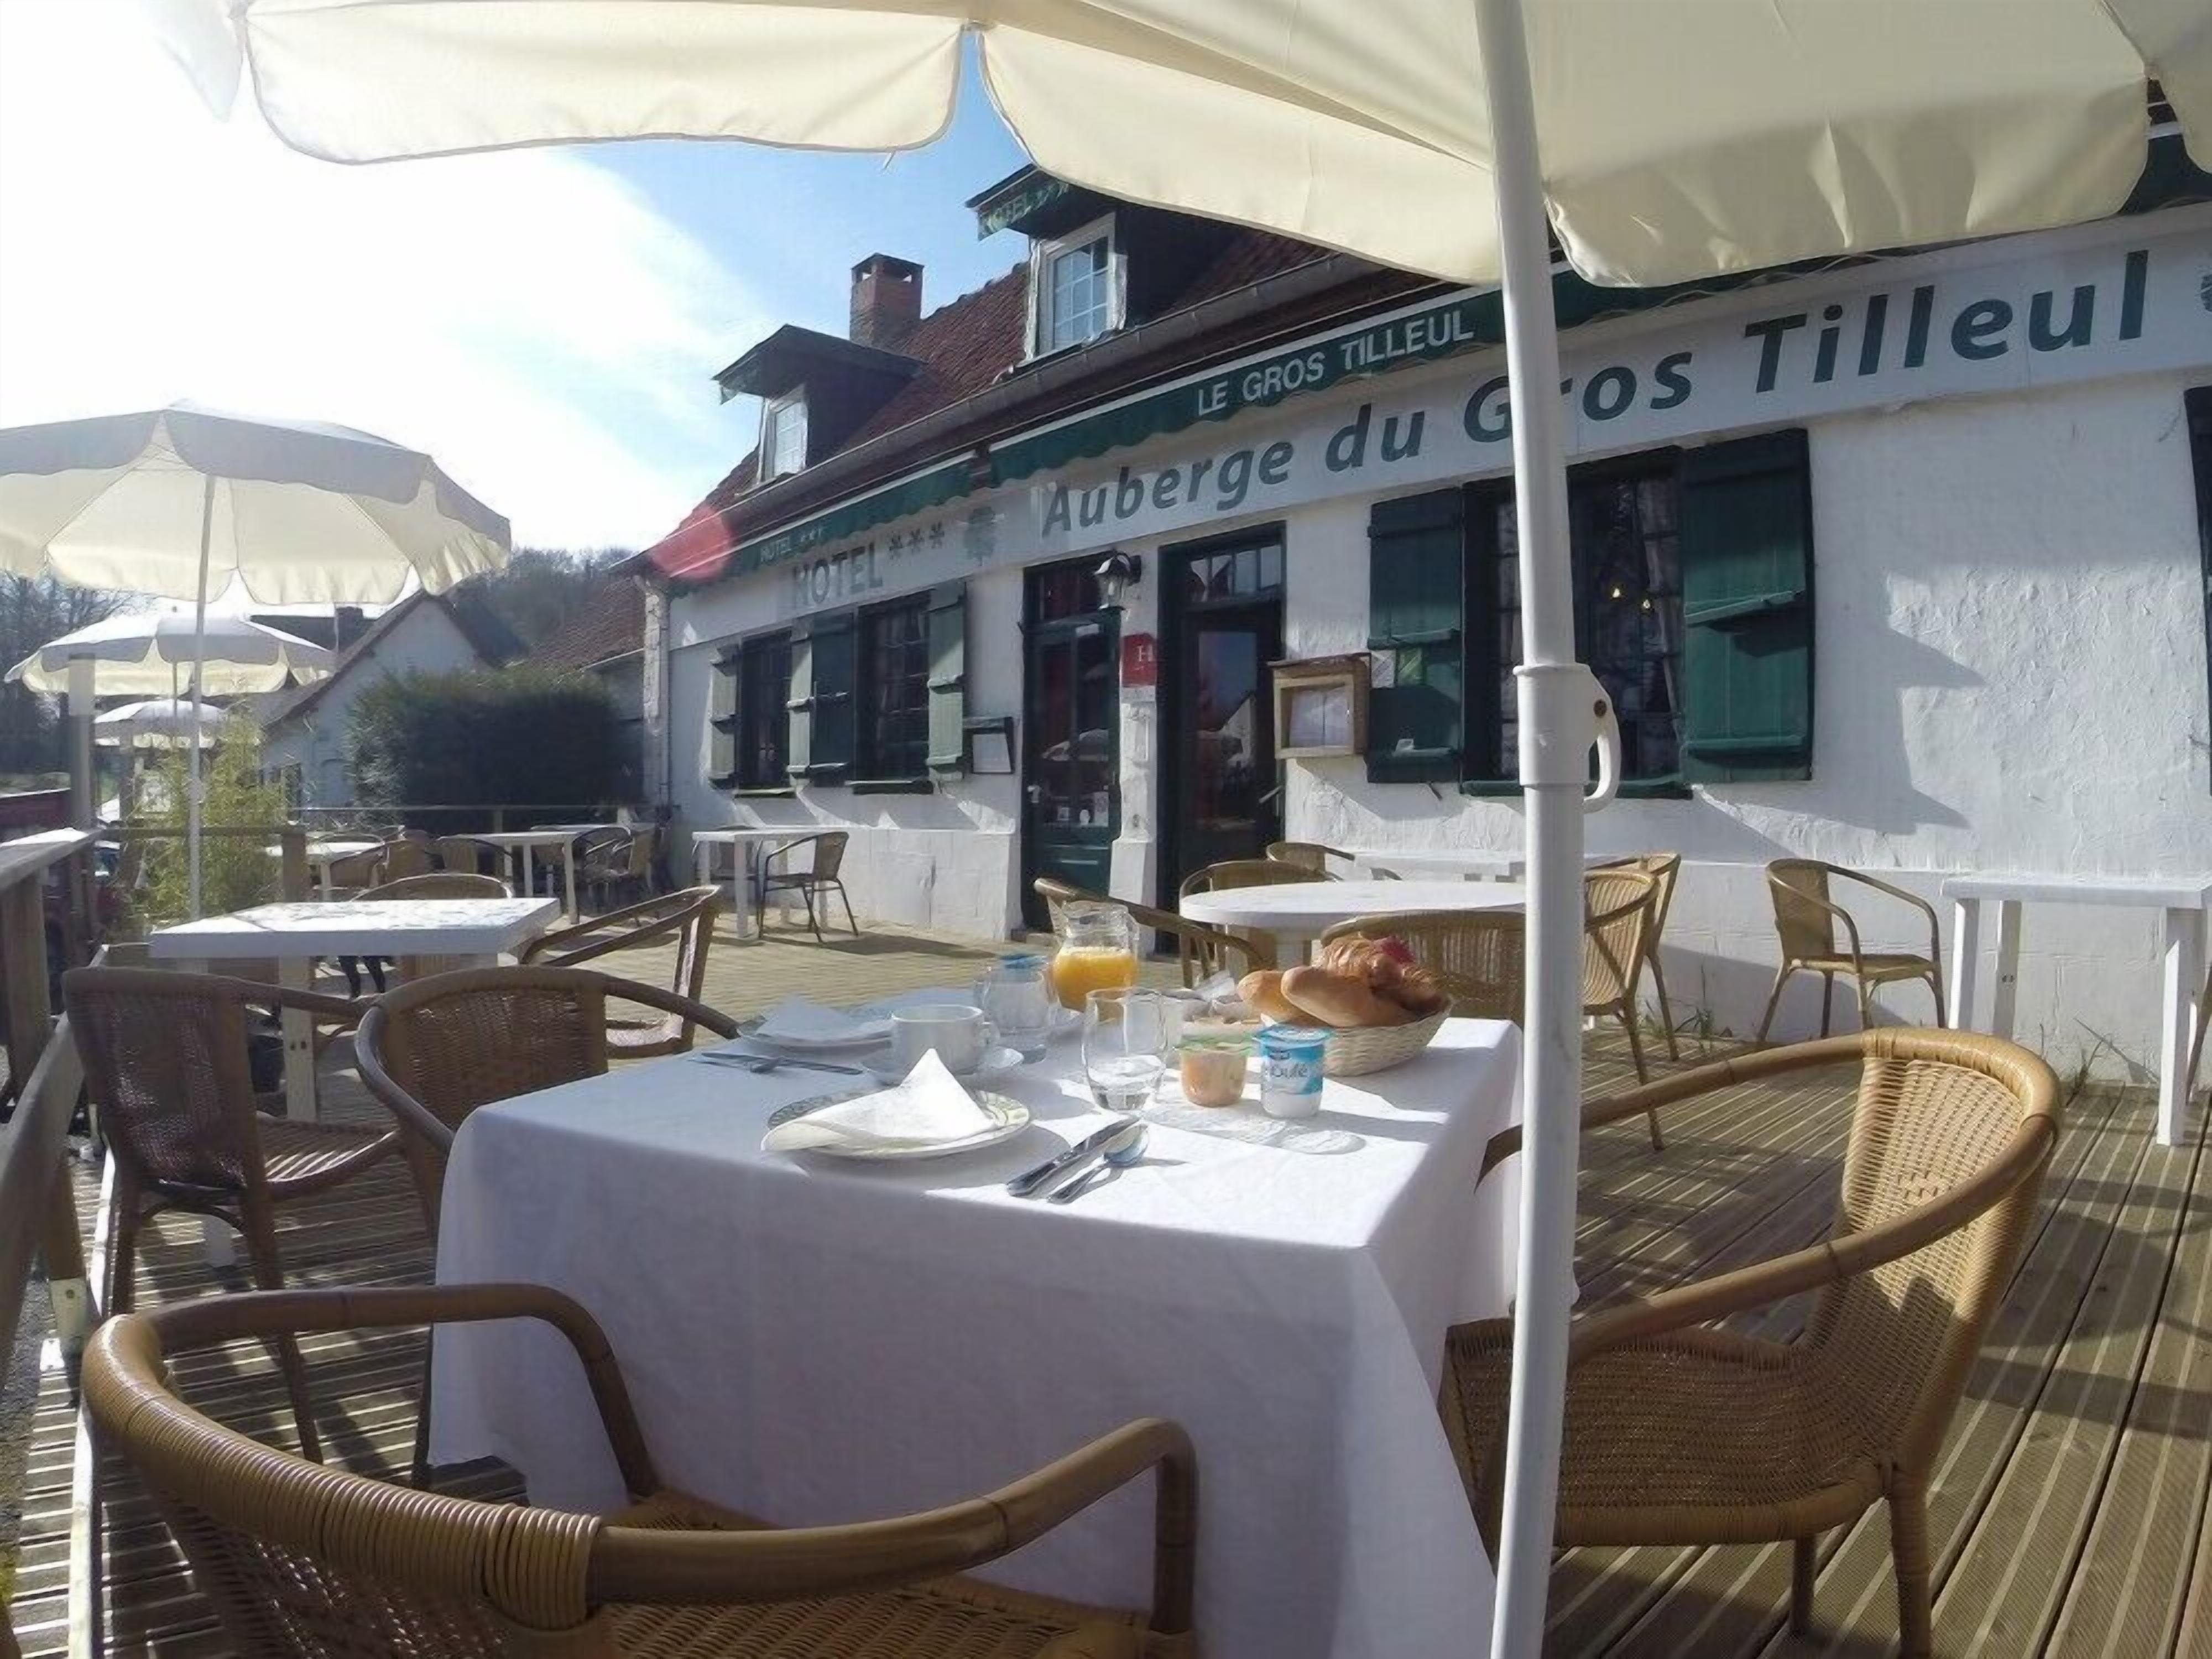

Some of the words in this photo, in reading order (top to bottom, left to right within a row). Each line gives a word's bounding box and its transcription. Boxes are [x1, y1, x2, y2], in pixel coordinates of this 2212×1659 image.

[1042, 442, 1294, 536] Auberge
[1327, 403, 1425, 472] du
[1464, 352, 1693, 442] Gos
[1745, 249, 2148, 393] Tilleul
[1198, 380, 1228, 416] LE
[1242, 352, 1326, 401] GROS
[1340, 309, 1474, 371] TILLEUL
[792, 541, 883, 606] HOTEL
